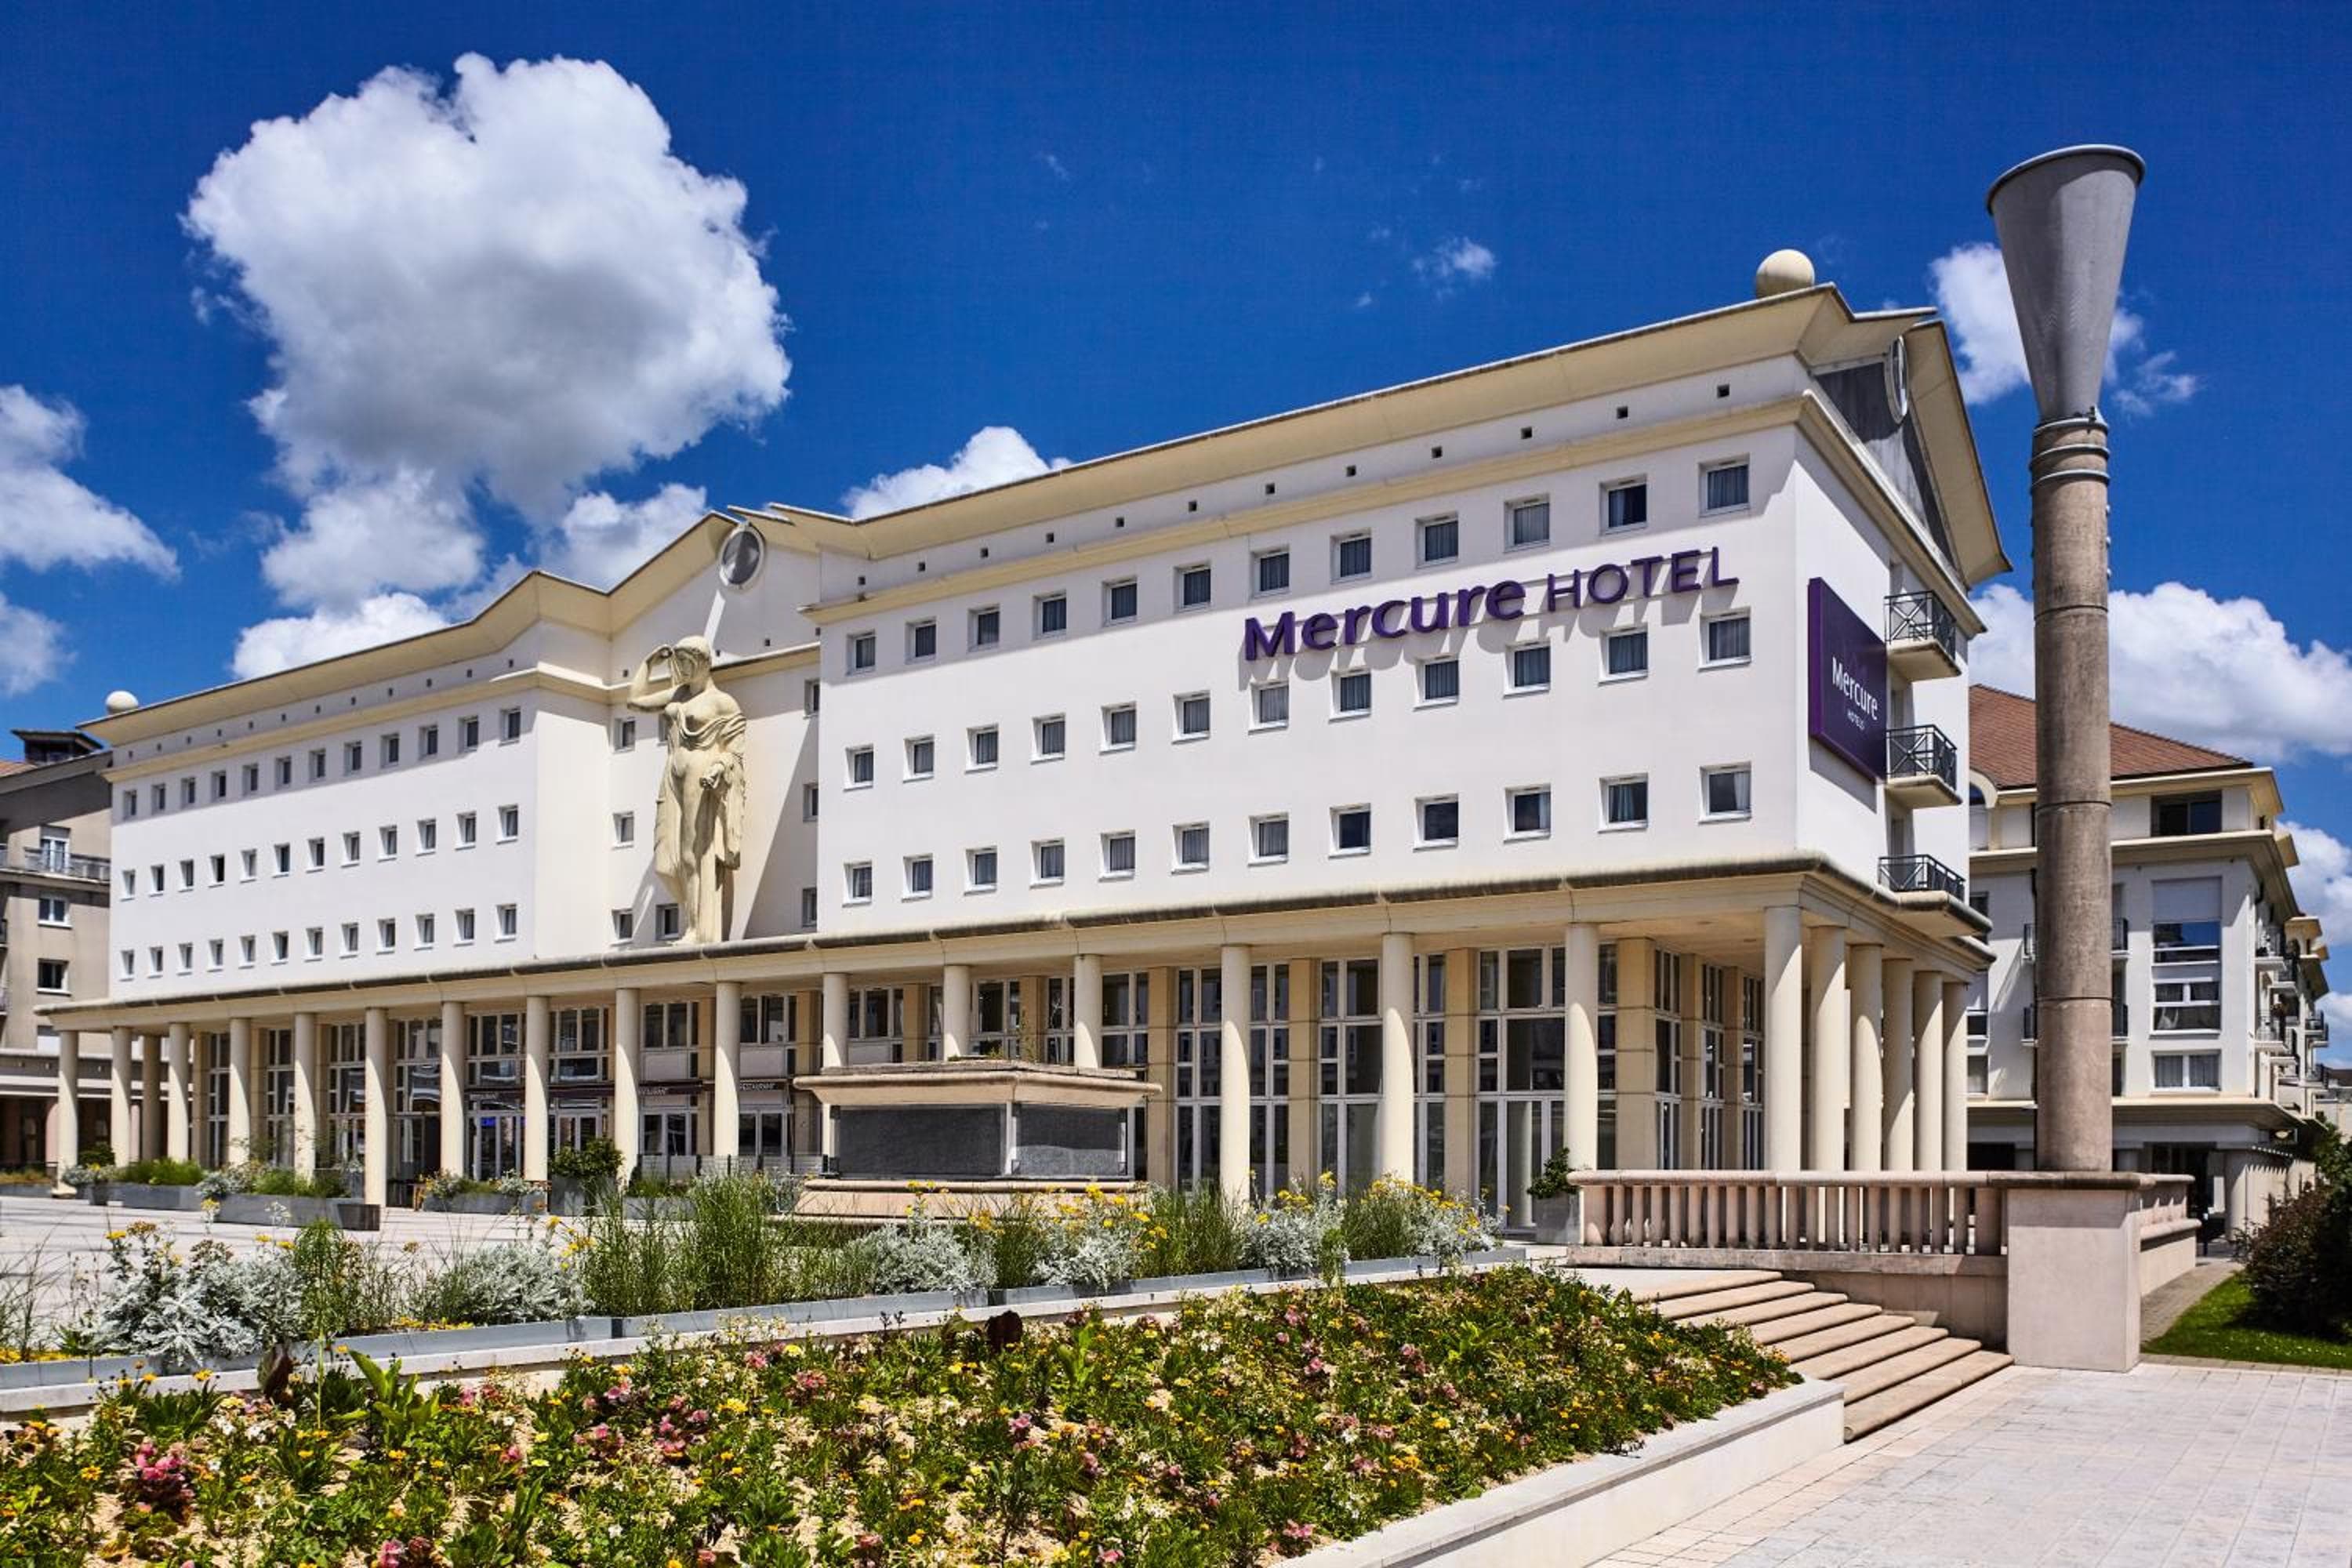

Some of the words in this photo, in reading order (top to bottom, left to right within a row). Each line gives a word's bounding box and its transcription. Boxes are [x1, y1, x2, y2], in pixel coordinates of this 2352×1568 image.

[1244, 579, 1526, 660] Mercure
[1547, 546, 1739, 612] HOTEL
[1832, 657, 1878, 720] Mercure
